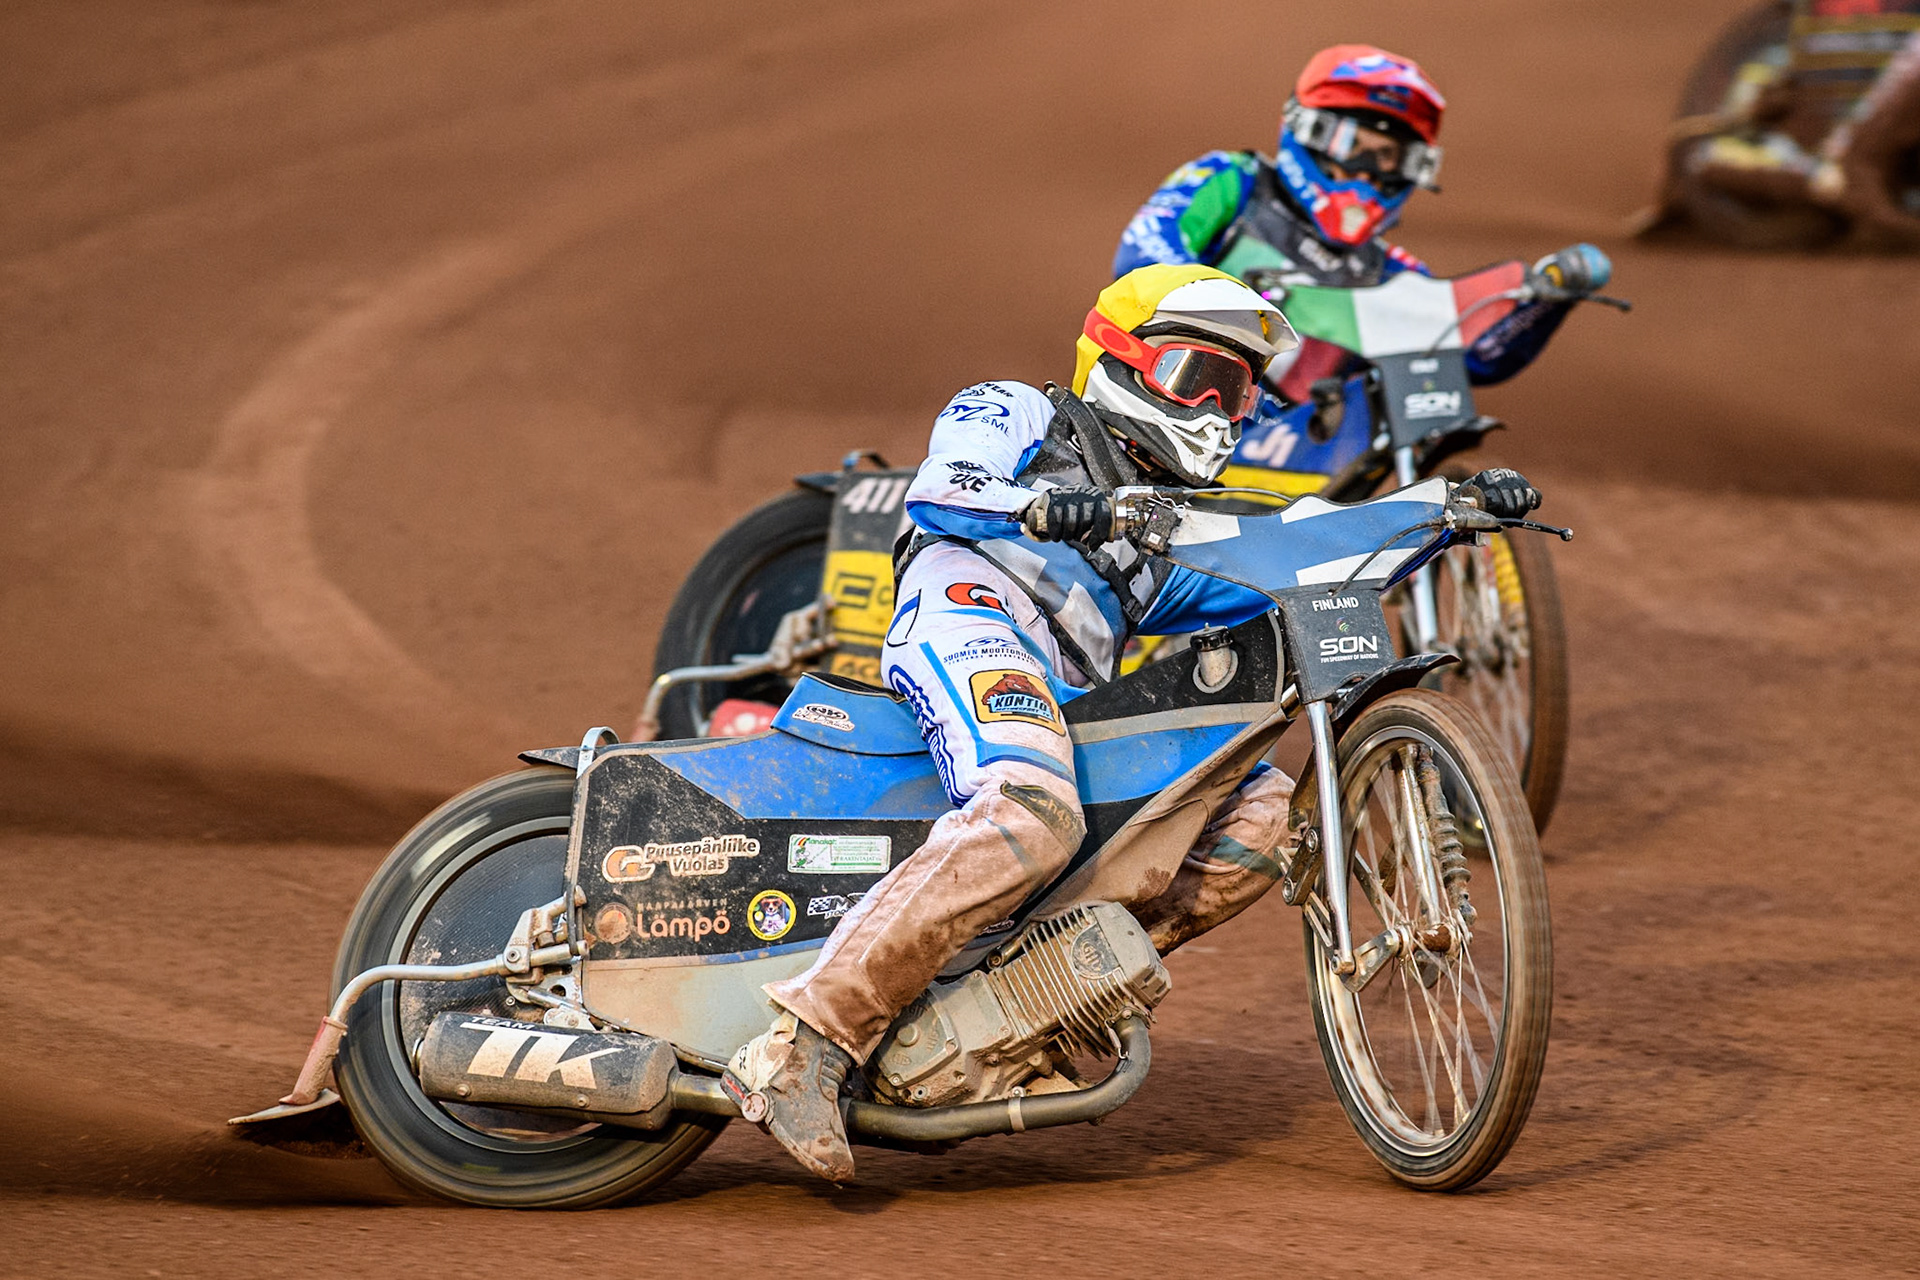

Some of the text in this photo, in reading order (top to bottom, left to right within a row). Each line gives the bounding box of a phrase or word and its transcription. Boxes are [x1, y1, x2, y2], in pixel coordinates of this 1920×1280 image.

[981, 416, 1009, 438] SML
[1312, 596, 1359, 612] FINLAND
[1320, 635, 1378, 656] SON
[943, 648, 978, 663] SUOMEN
[994, 695, 1048, 712] KONTIO
[646, 838, 757, 859] Puusepänliike
[673, 857, 725, 873] Vuolas
[637, 910, 731, 943] Lämpö
[472, 1016, 535, 1030] TEAM
